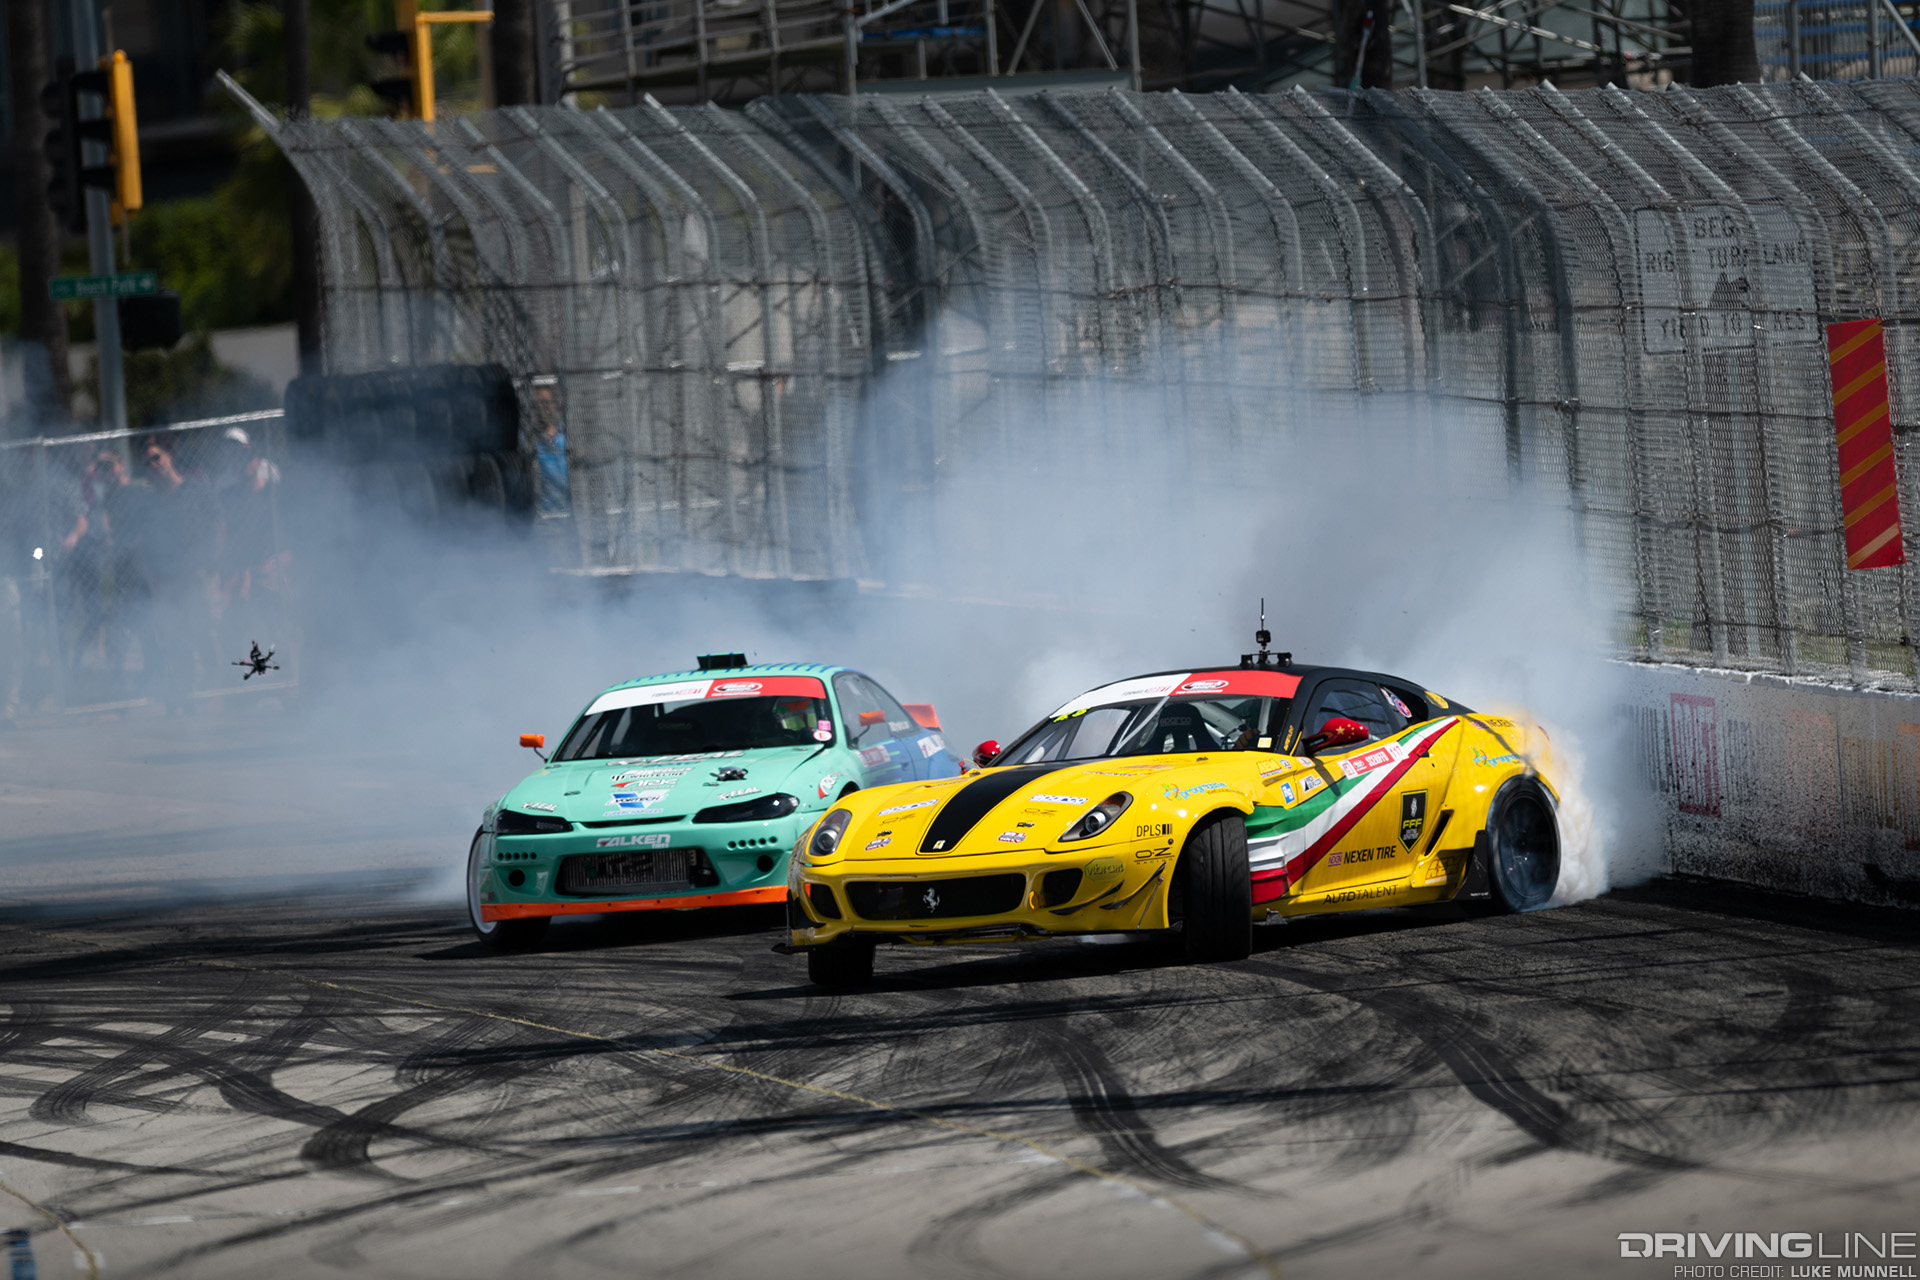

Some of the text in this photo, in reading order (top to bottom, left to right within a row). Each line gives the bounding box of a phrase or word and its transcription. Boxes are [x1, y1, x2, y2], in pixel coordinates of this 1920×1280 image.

[1136, 824, 1161, 838] DPLS
[1402, 818, 1423, 830] FFF
[596, 833, 671, 849] FALKEN
[1343, 848, 1375, 865] NEXEN
[1376, 845, 1397, 861] TIRE
[1322, 884, 1399, 905] AUTOTALENT
